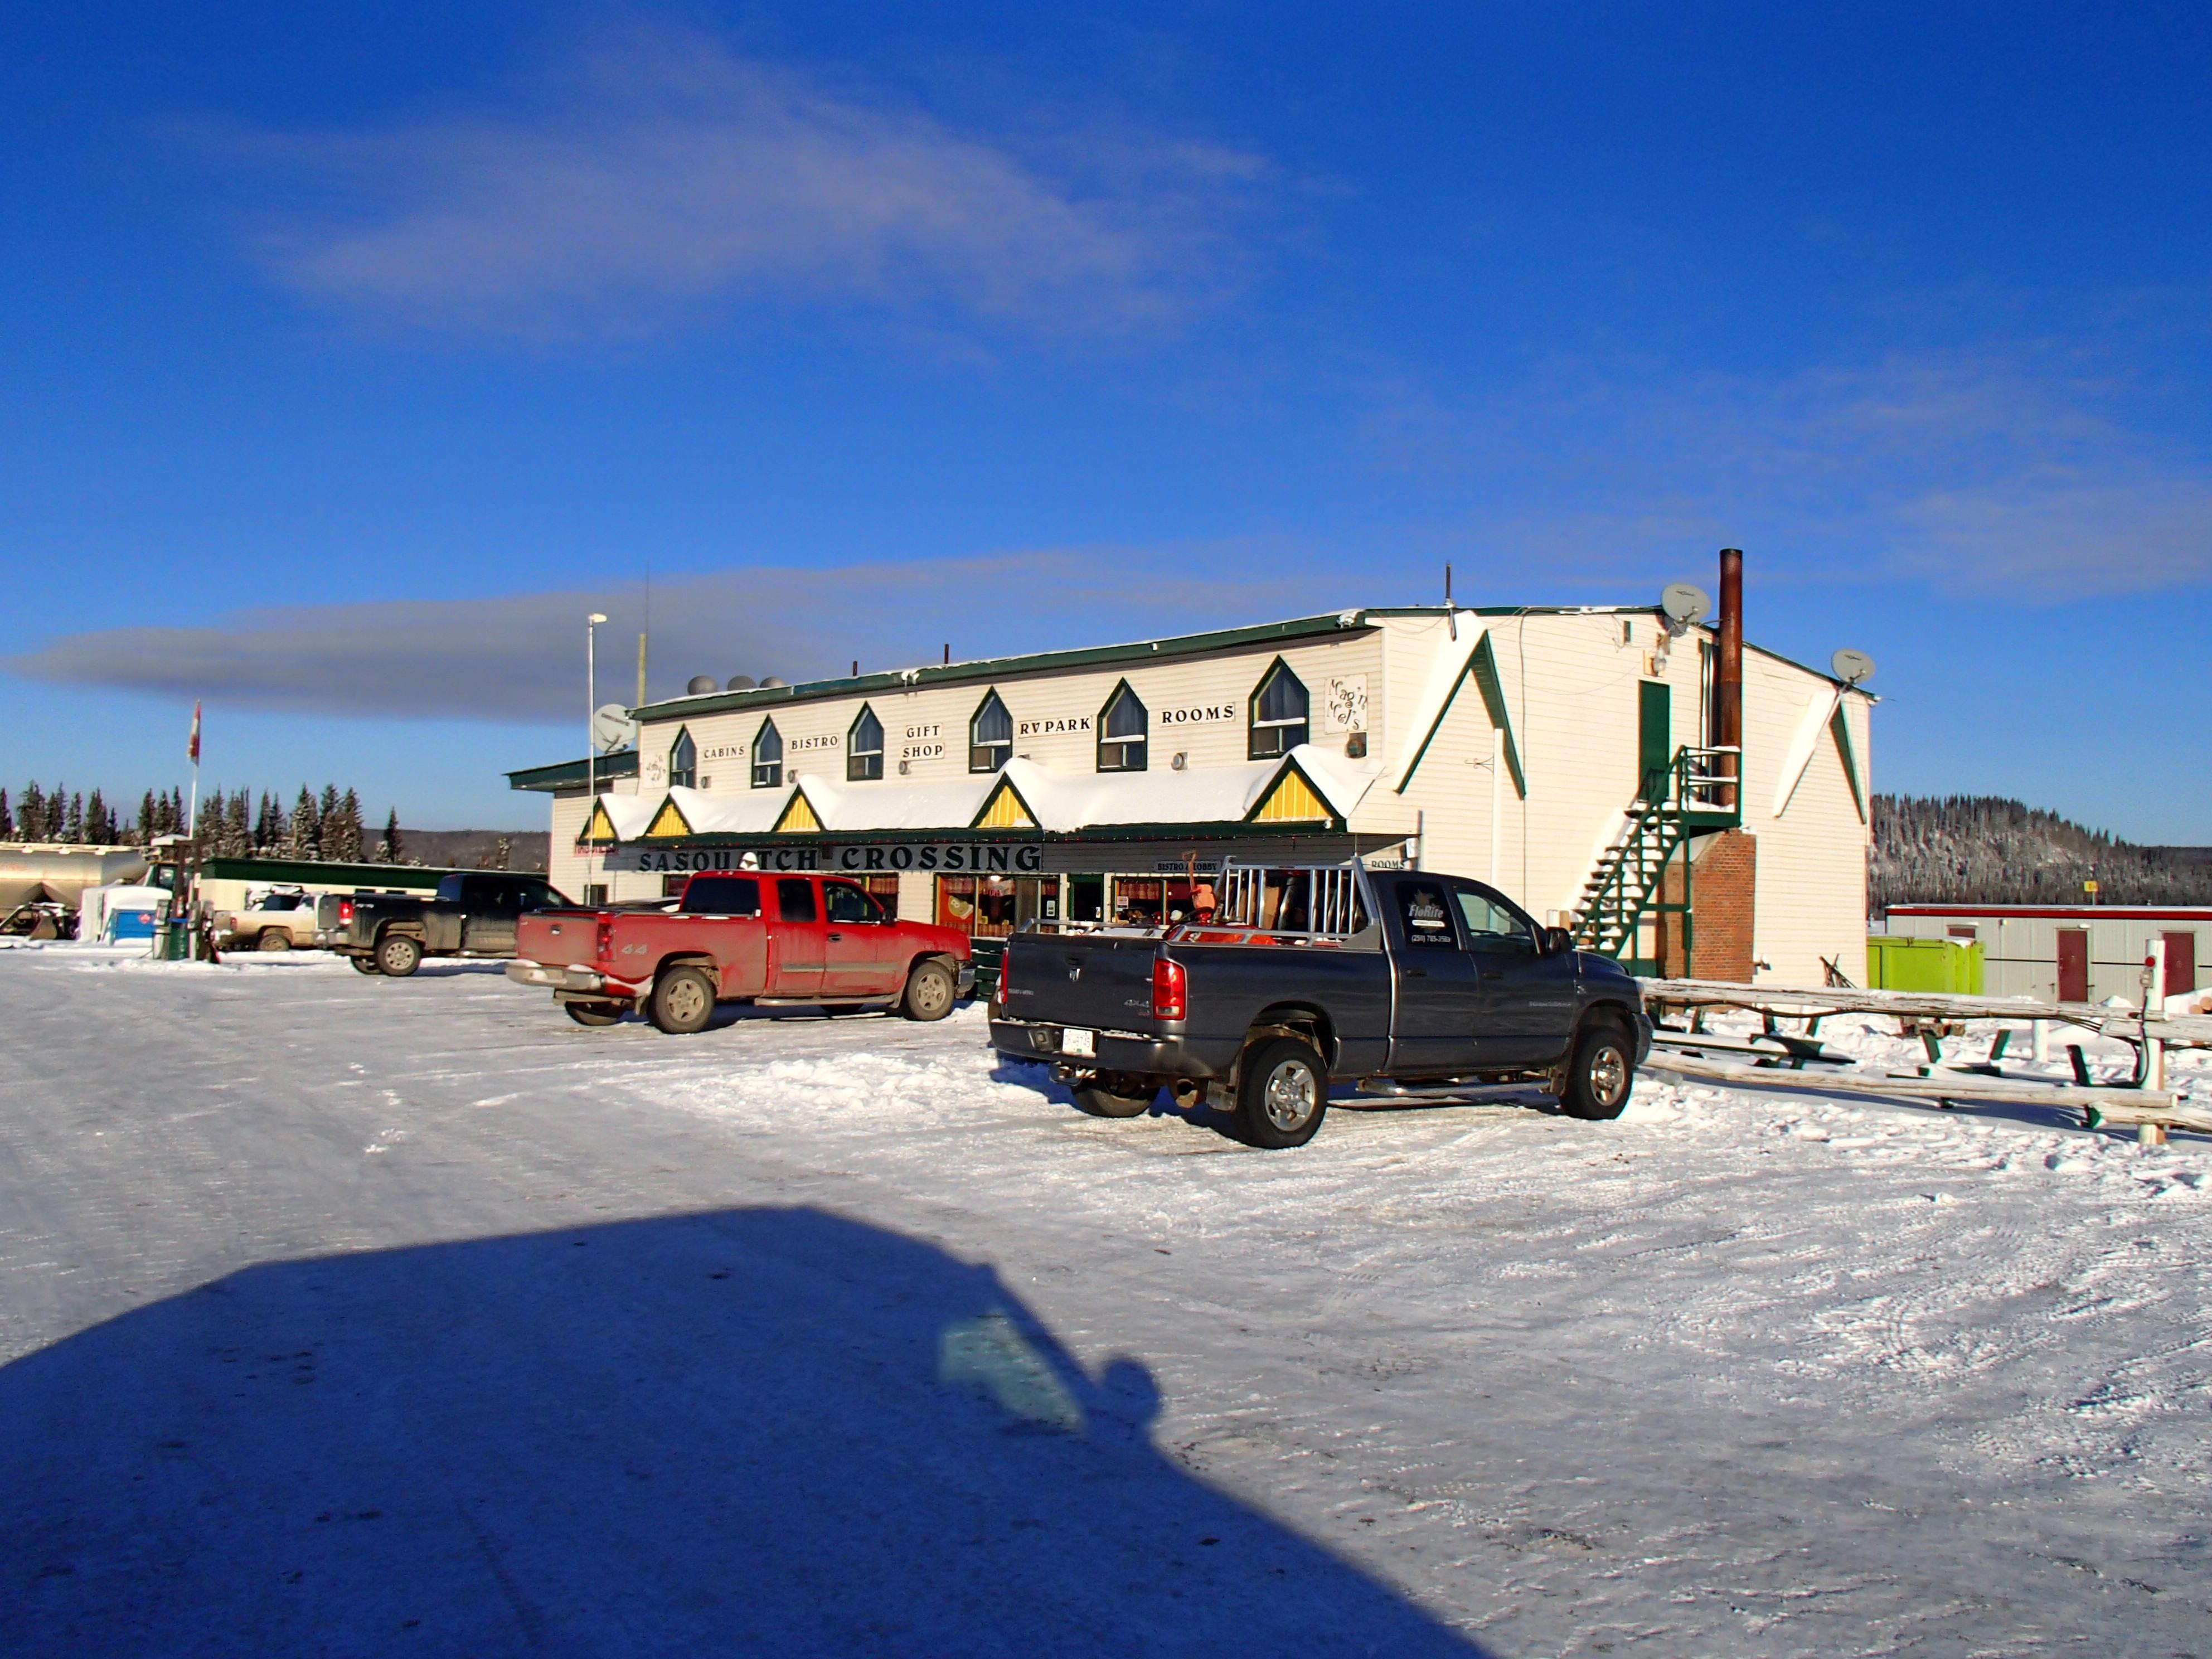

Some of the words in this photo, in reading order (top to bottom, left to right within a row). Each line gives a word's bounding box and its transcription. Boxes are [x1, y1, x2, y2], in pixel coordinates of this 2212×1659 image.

[1162, 705, 1234, 724] ROOMS
[906, 725, 940, 738] GIFT
[1020, 722, 1040, 735] RV
[1045, 718, 1090, 733] PARK
[792, 736, 838, 750] BISTRO
[704, 746, 745, 759] CABINS
[903, 745, 943, 758] SHOP
[841, 846, 1040, 871] CROSSING
[1157, 862, 1184, 871] BISTRO
